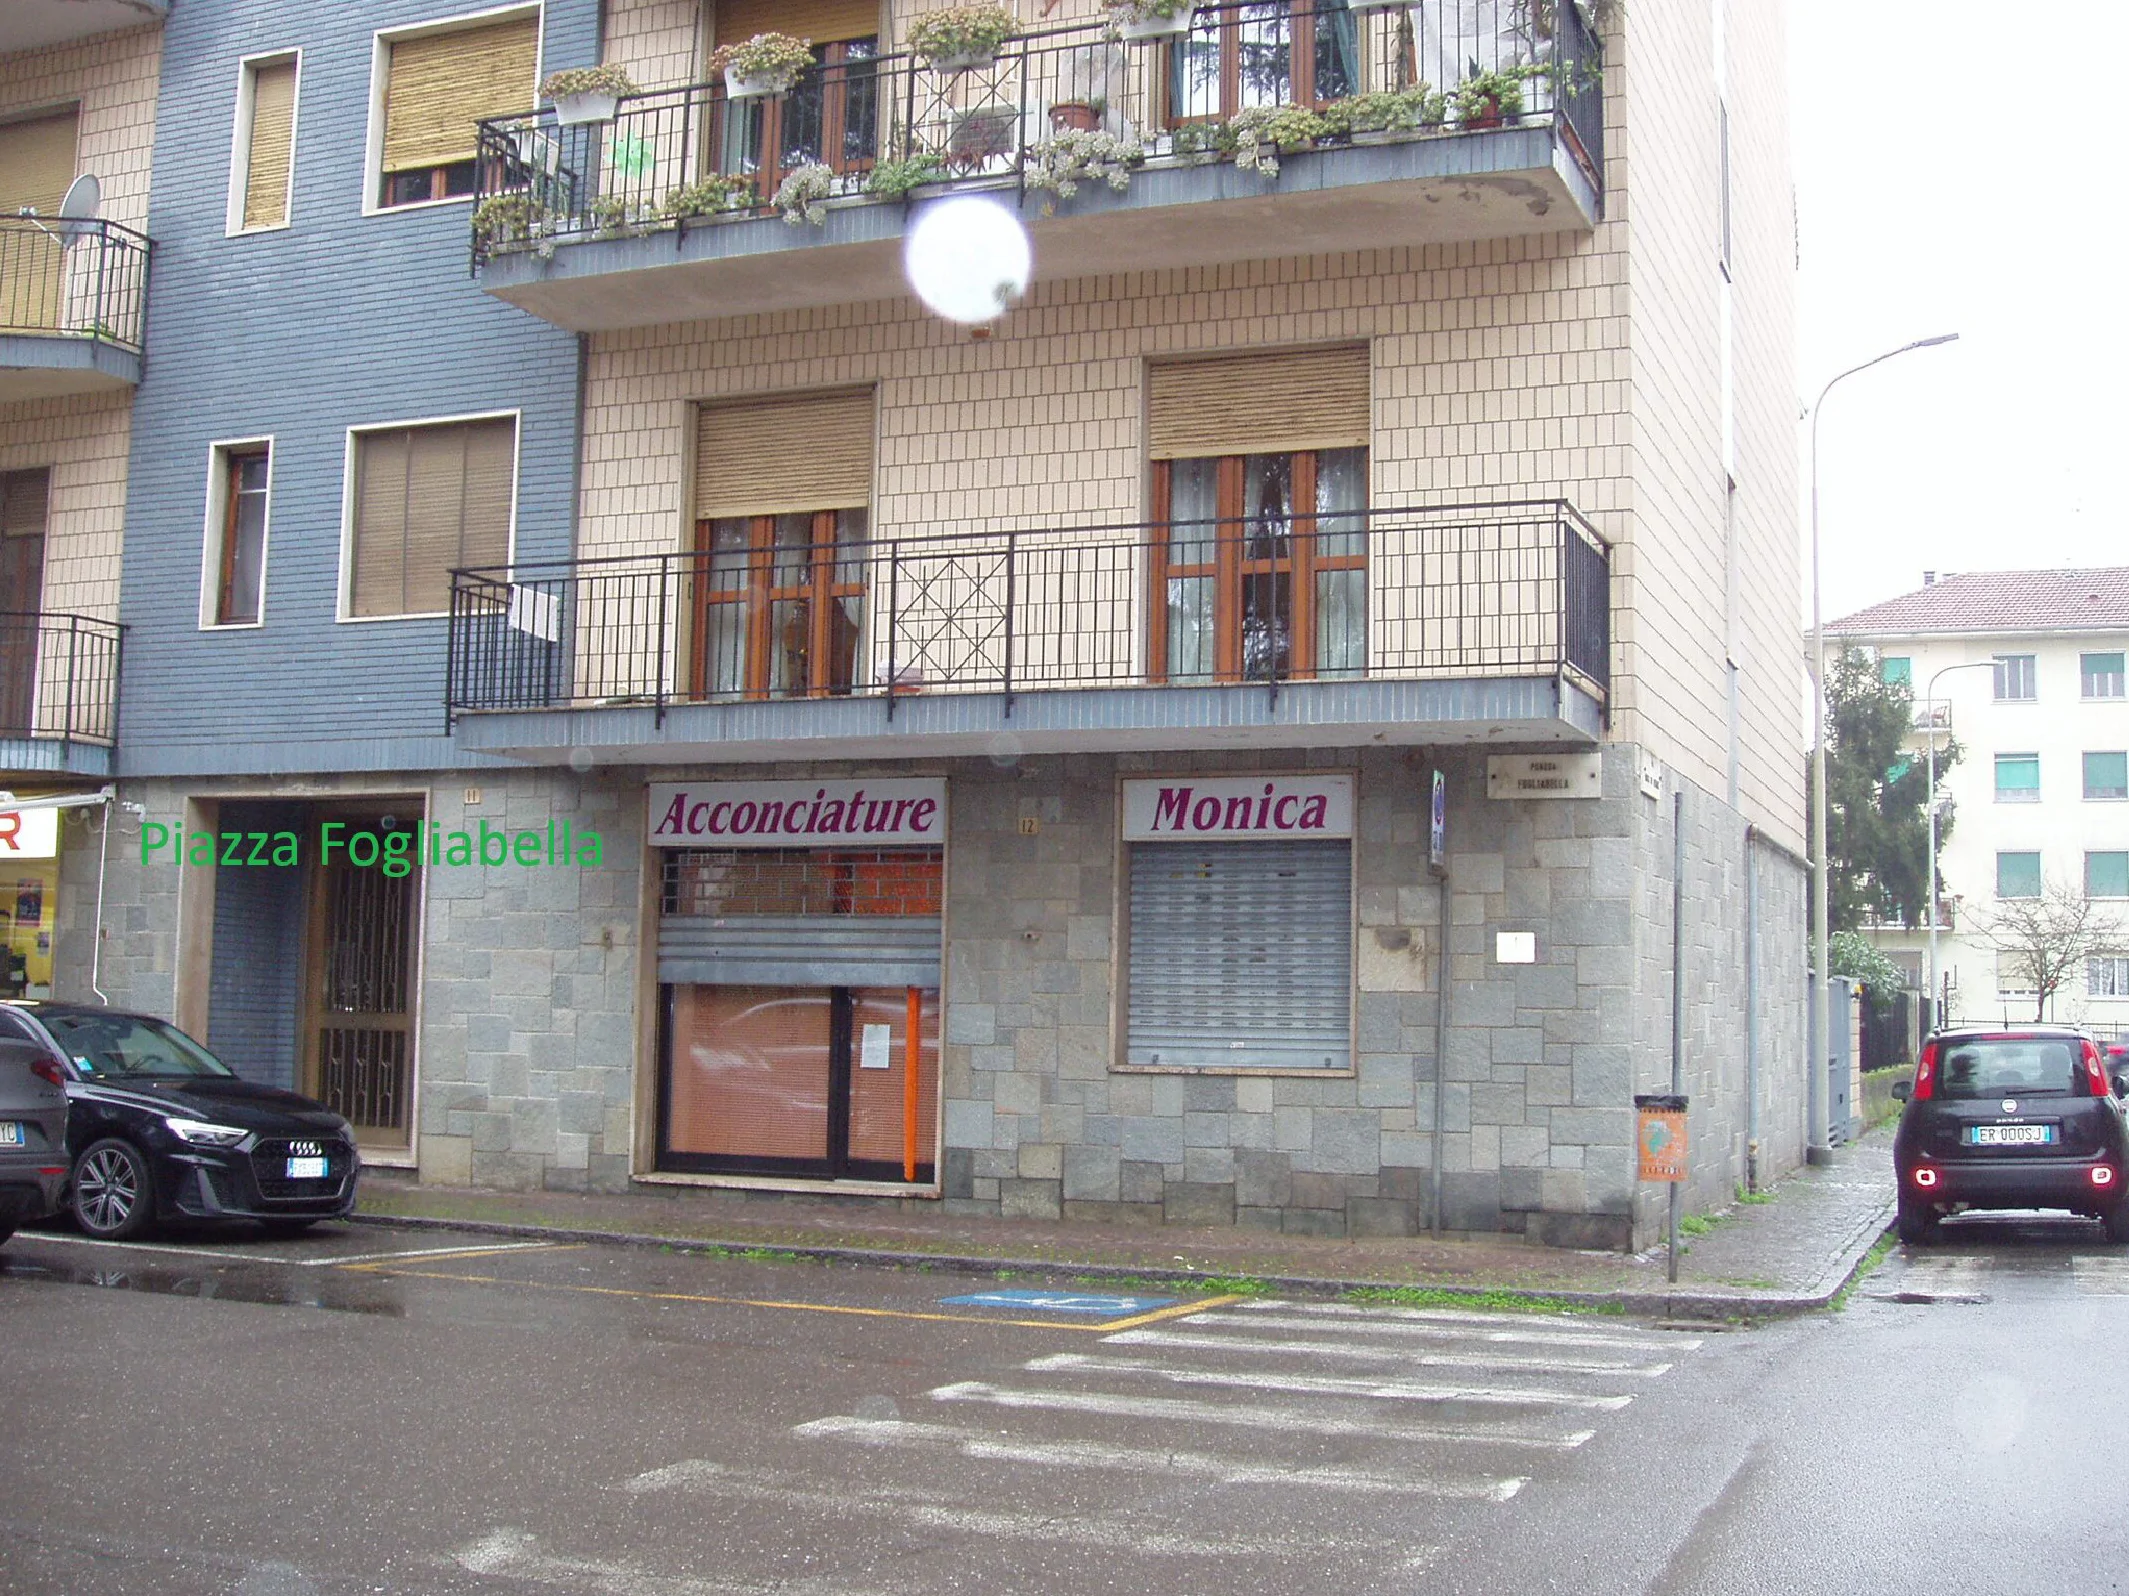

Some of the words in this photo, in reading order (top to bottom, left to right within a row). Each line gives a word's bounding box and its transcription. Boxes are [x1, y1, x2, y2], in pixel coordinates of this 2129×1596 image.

[654, 788, 937, 835] Acconciature
[1022, 819, 1034, 833] 12
[1151, 783, 1328, 831] Monica
